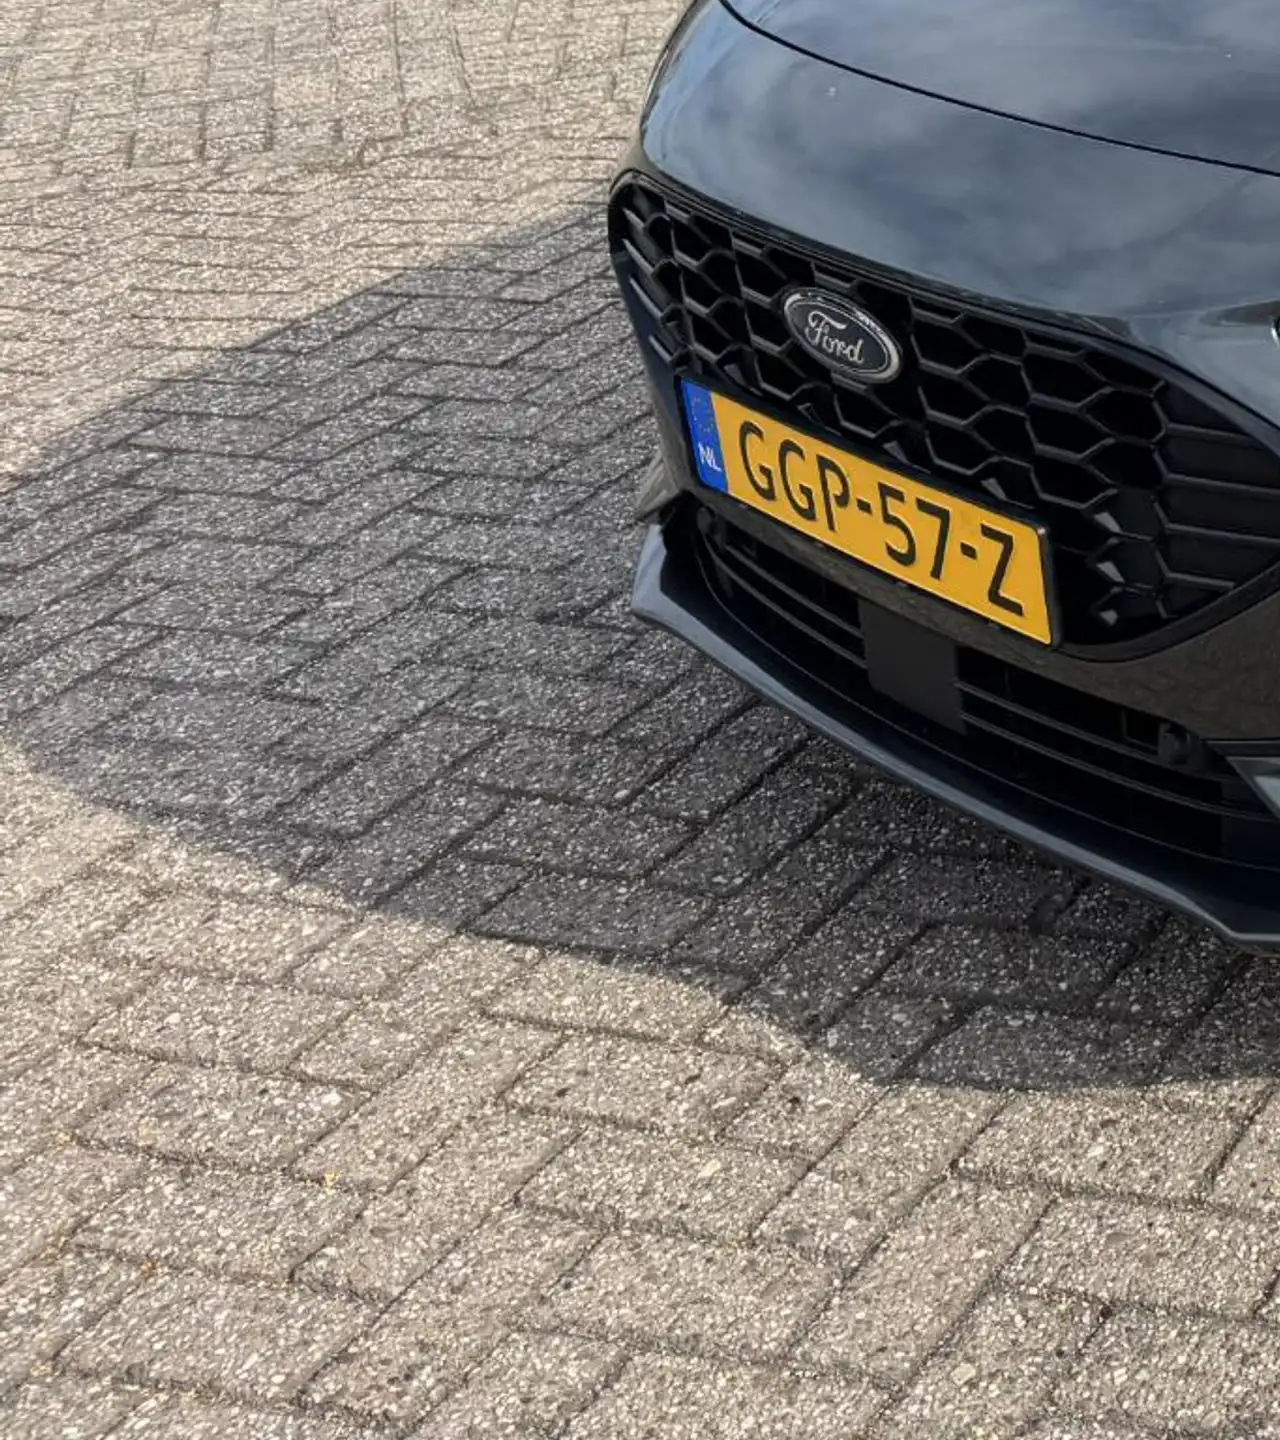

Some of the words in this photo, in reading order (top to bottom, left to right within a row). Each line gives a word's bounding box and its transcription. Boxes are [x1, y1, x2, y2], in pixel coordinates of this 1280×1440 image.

[804, 310, 864, 364] Ford
[699, 441, 722, 471] NL
[738, 420, 1024, 617] GGP-57-Z
